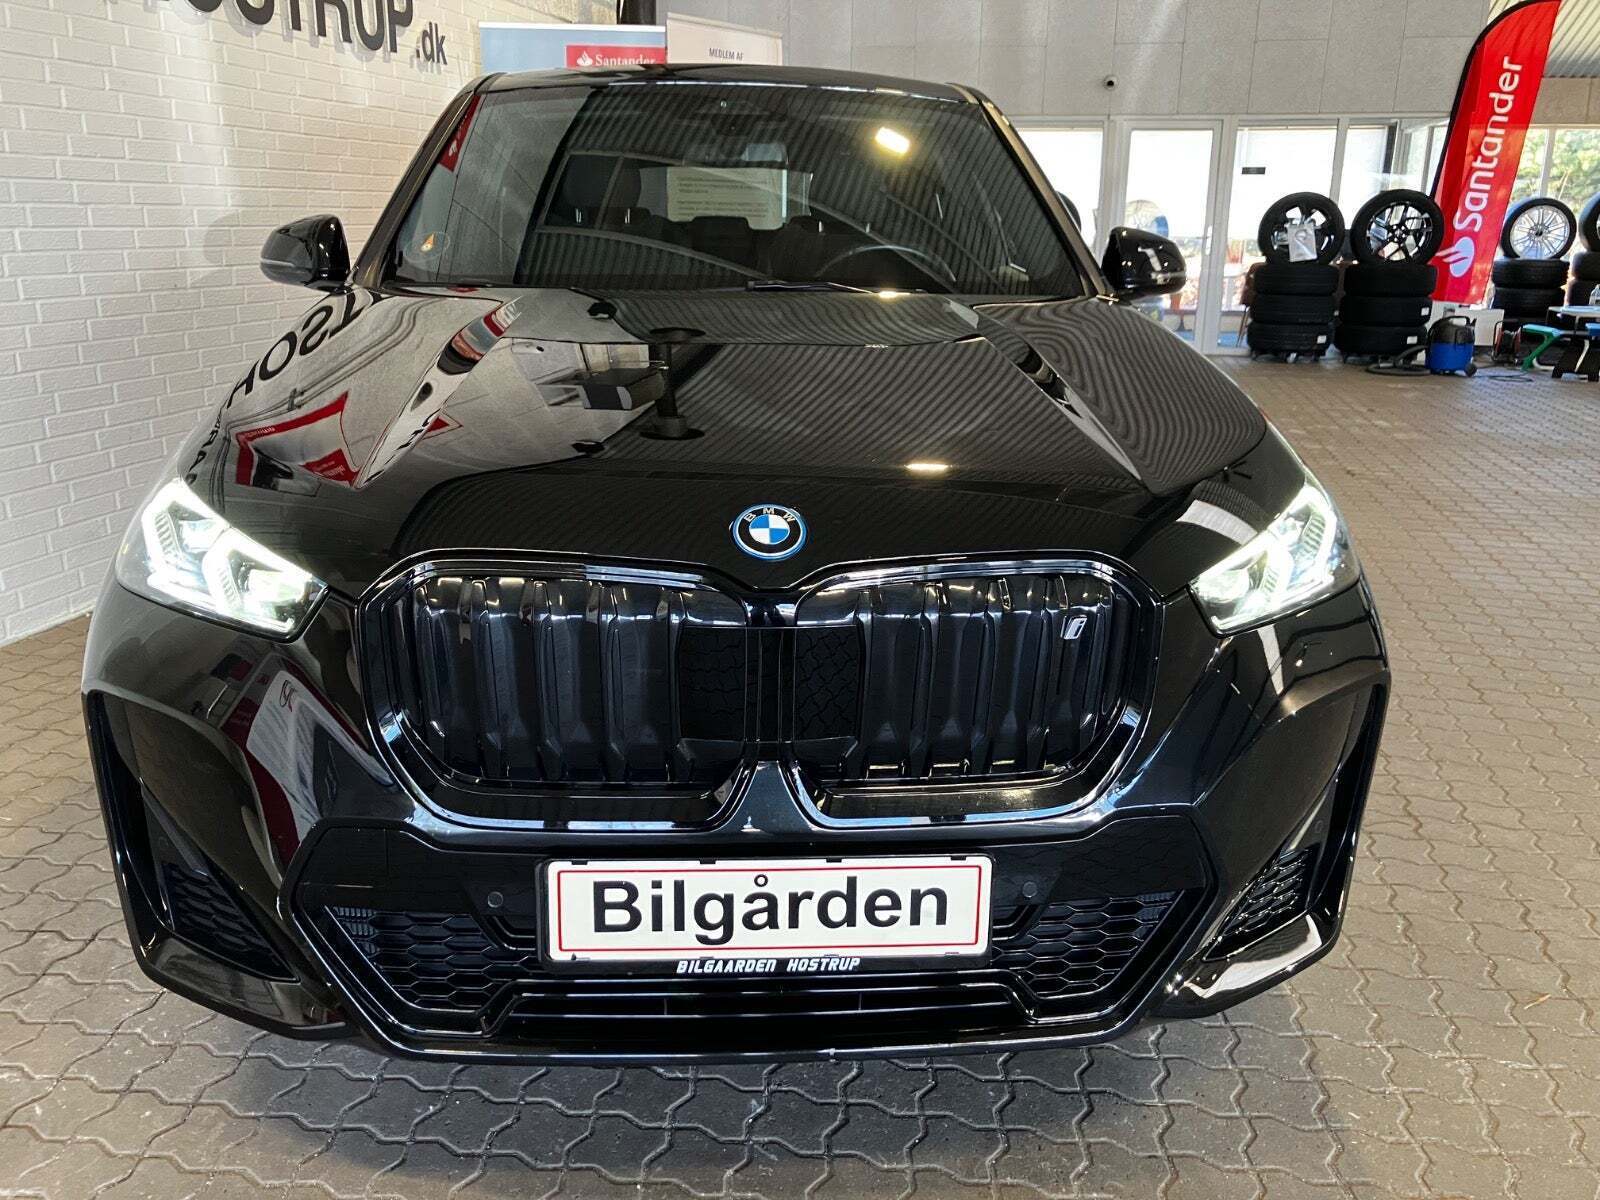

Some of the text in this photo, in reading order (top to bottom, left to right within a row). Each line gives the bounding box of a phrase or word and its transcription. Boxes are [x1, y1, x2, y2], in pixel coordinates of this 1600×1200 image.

[595, 54, 656, 67] Santander
[709, 47, 735, 60] MEDLEM
[1453, 56, 1523, 233] Santander
[743, 507, 796, 522] BMW
[592, 874, 949, 946] Bilgården
[676, 956, 861, 974] BILGAARDEN HOSTRUP
